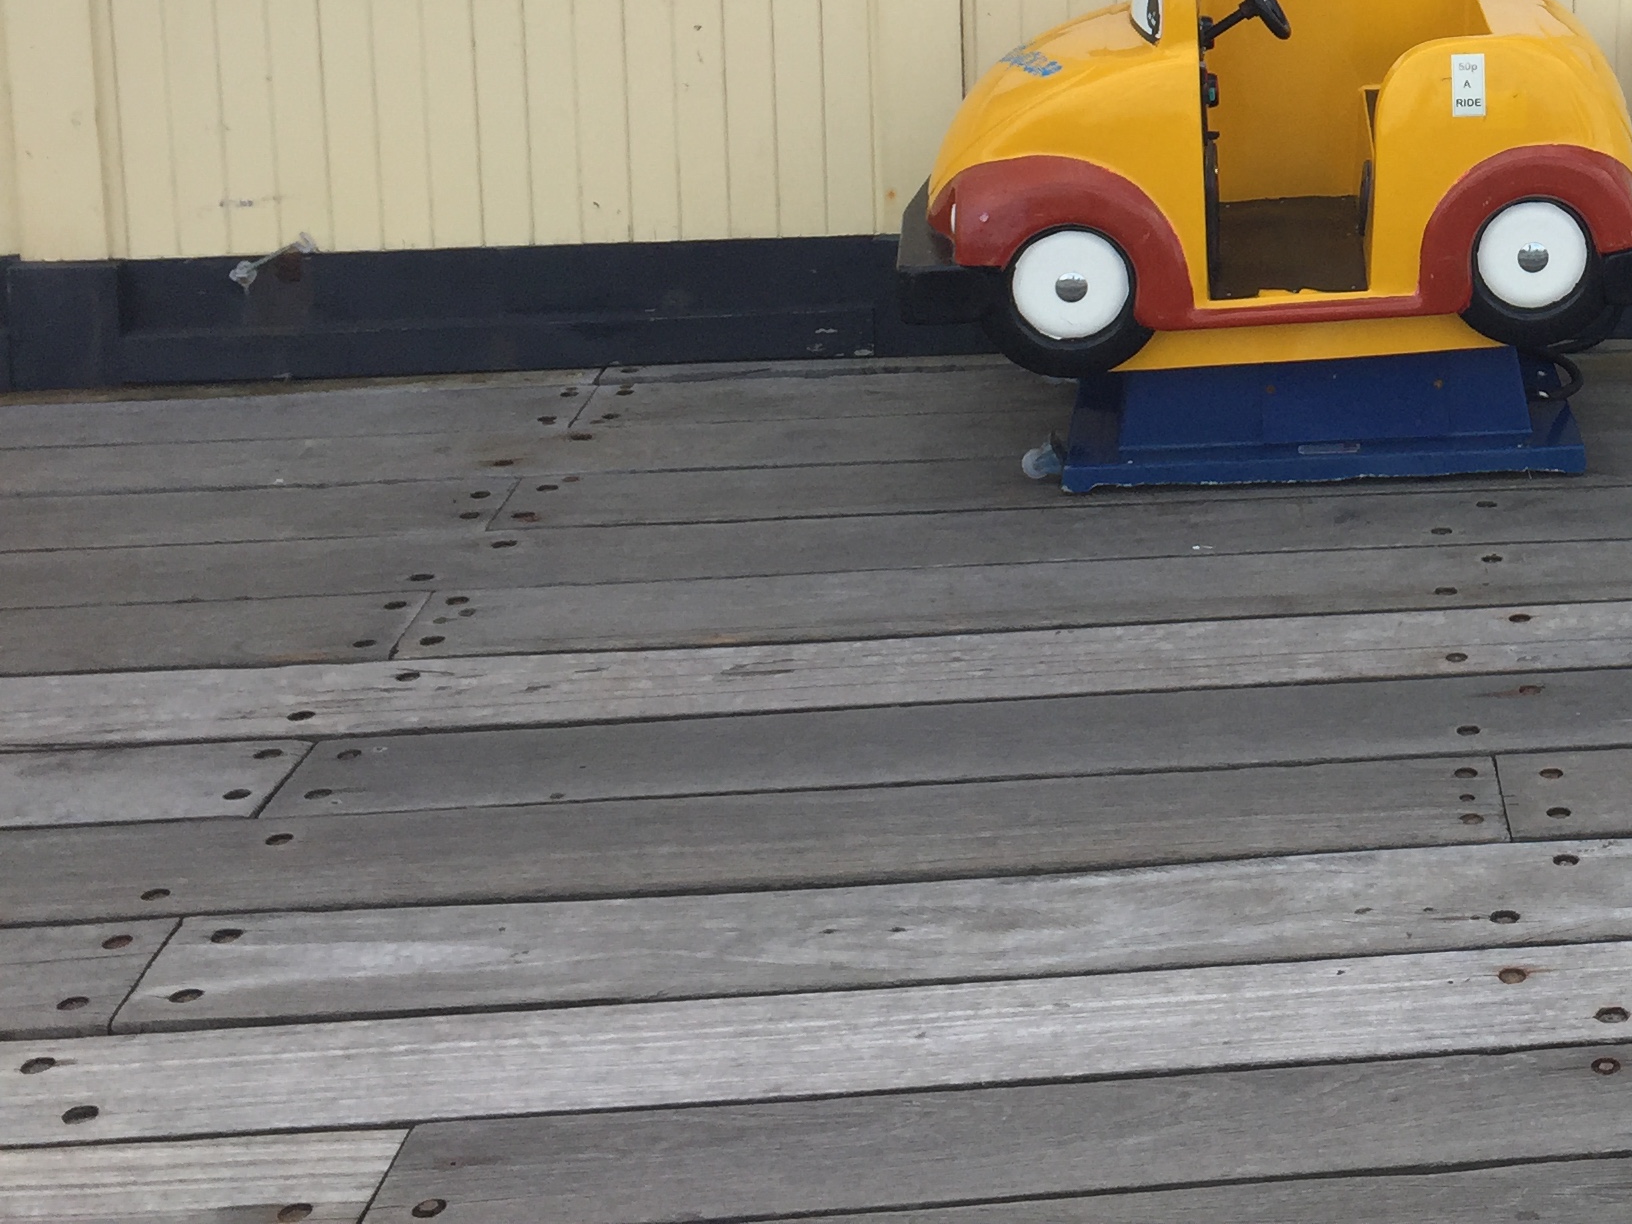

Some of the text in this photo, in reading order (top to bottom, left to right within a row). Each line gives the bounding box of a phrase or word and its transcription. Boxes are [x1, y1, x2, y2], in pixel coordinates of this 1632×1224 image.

[1458, 62, 1478, 73] 50p
[1463, 79, 1471, 89] A
[1455, 98, 1482, 107] RIDE
